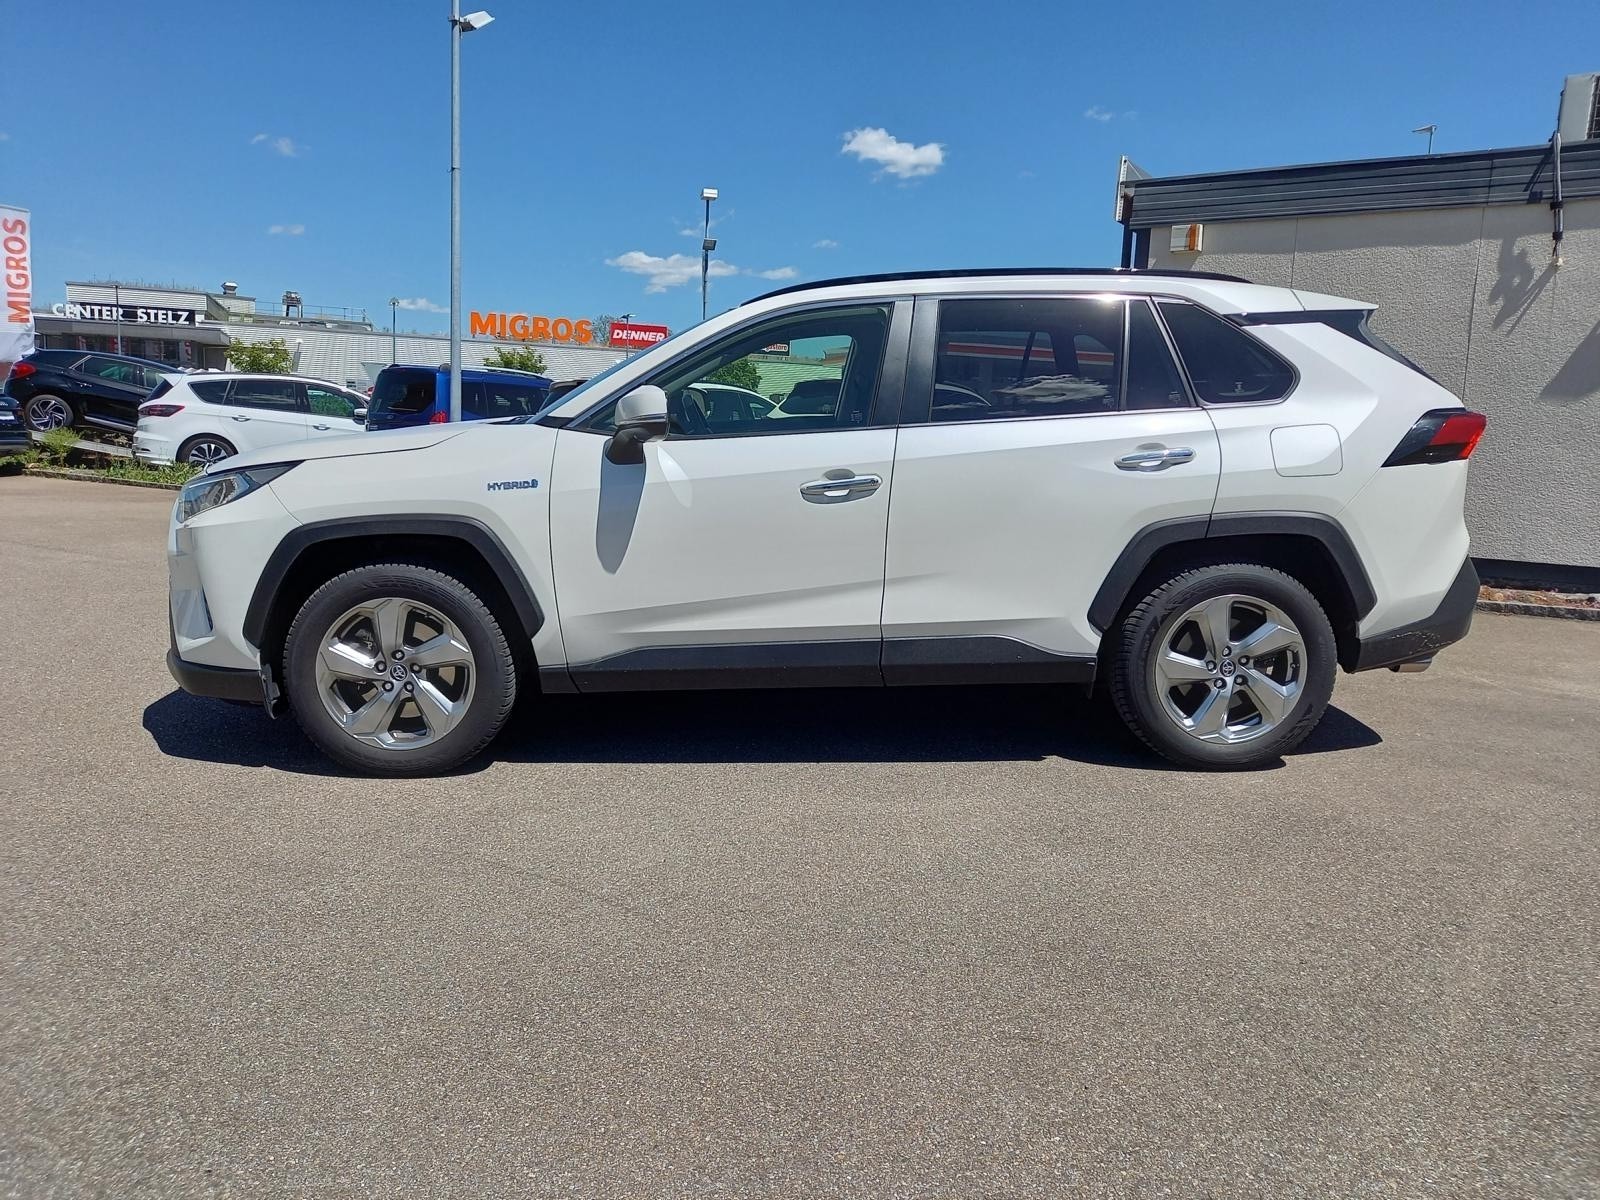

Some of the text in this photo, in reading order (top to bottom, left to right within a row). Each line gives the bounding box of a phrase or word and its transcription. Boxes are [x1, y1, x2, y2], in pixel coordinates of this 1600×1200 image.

[2, 217, 30, 323] MIGROS
[52, 303, 189, 325] CENTER STELZ
[470, 311, 593, 344] MIGROS
[612, 328, 666, 343] DENNER
[487, 480, 531, 491] HYBRID
